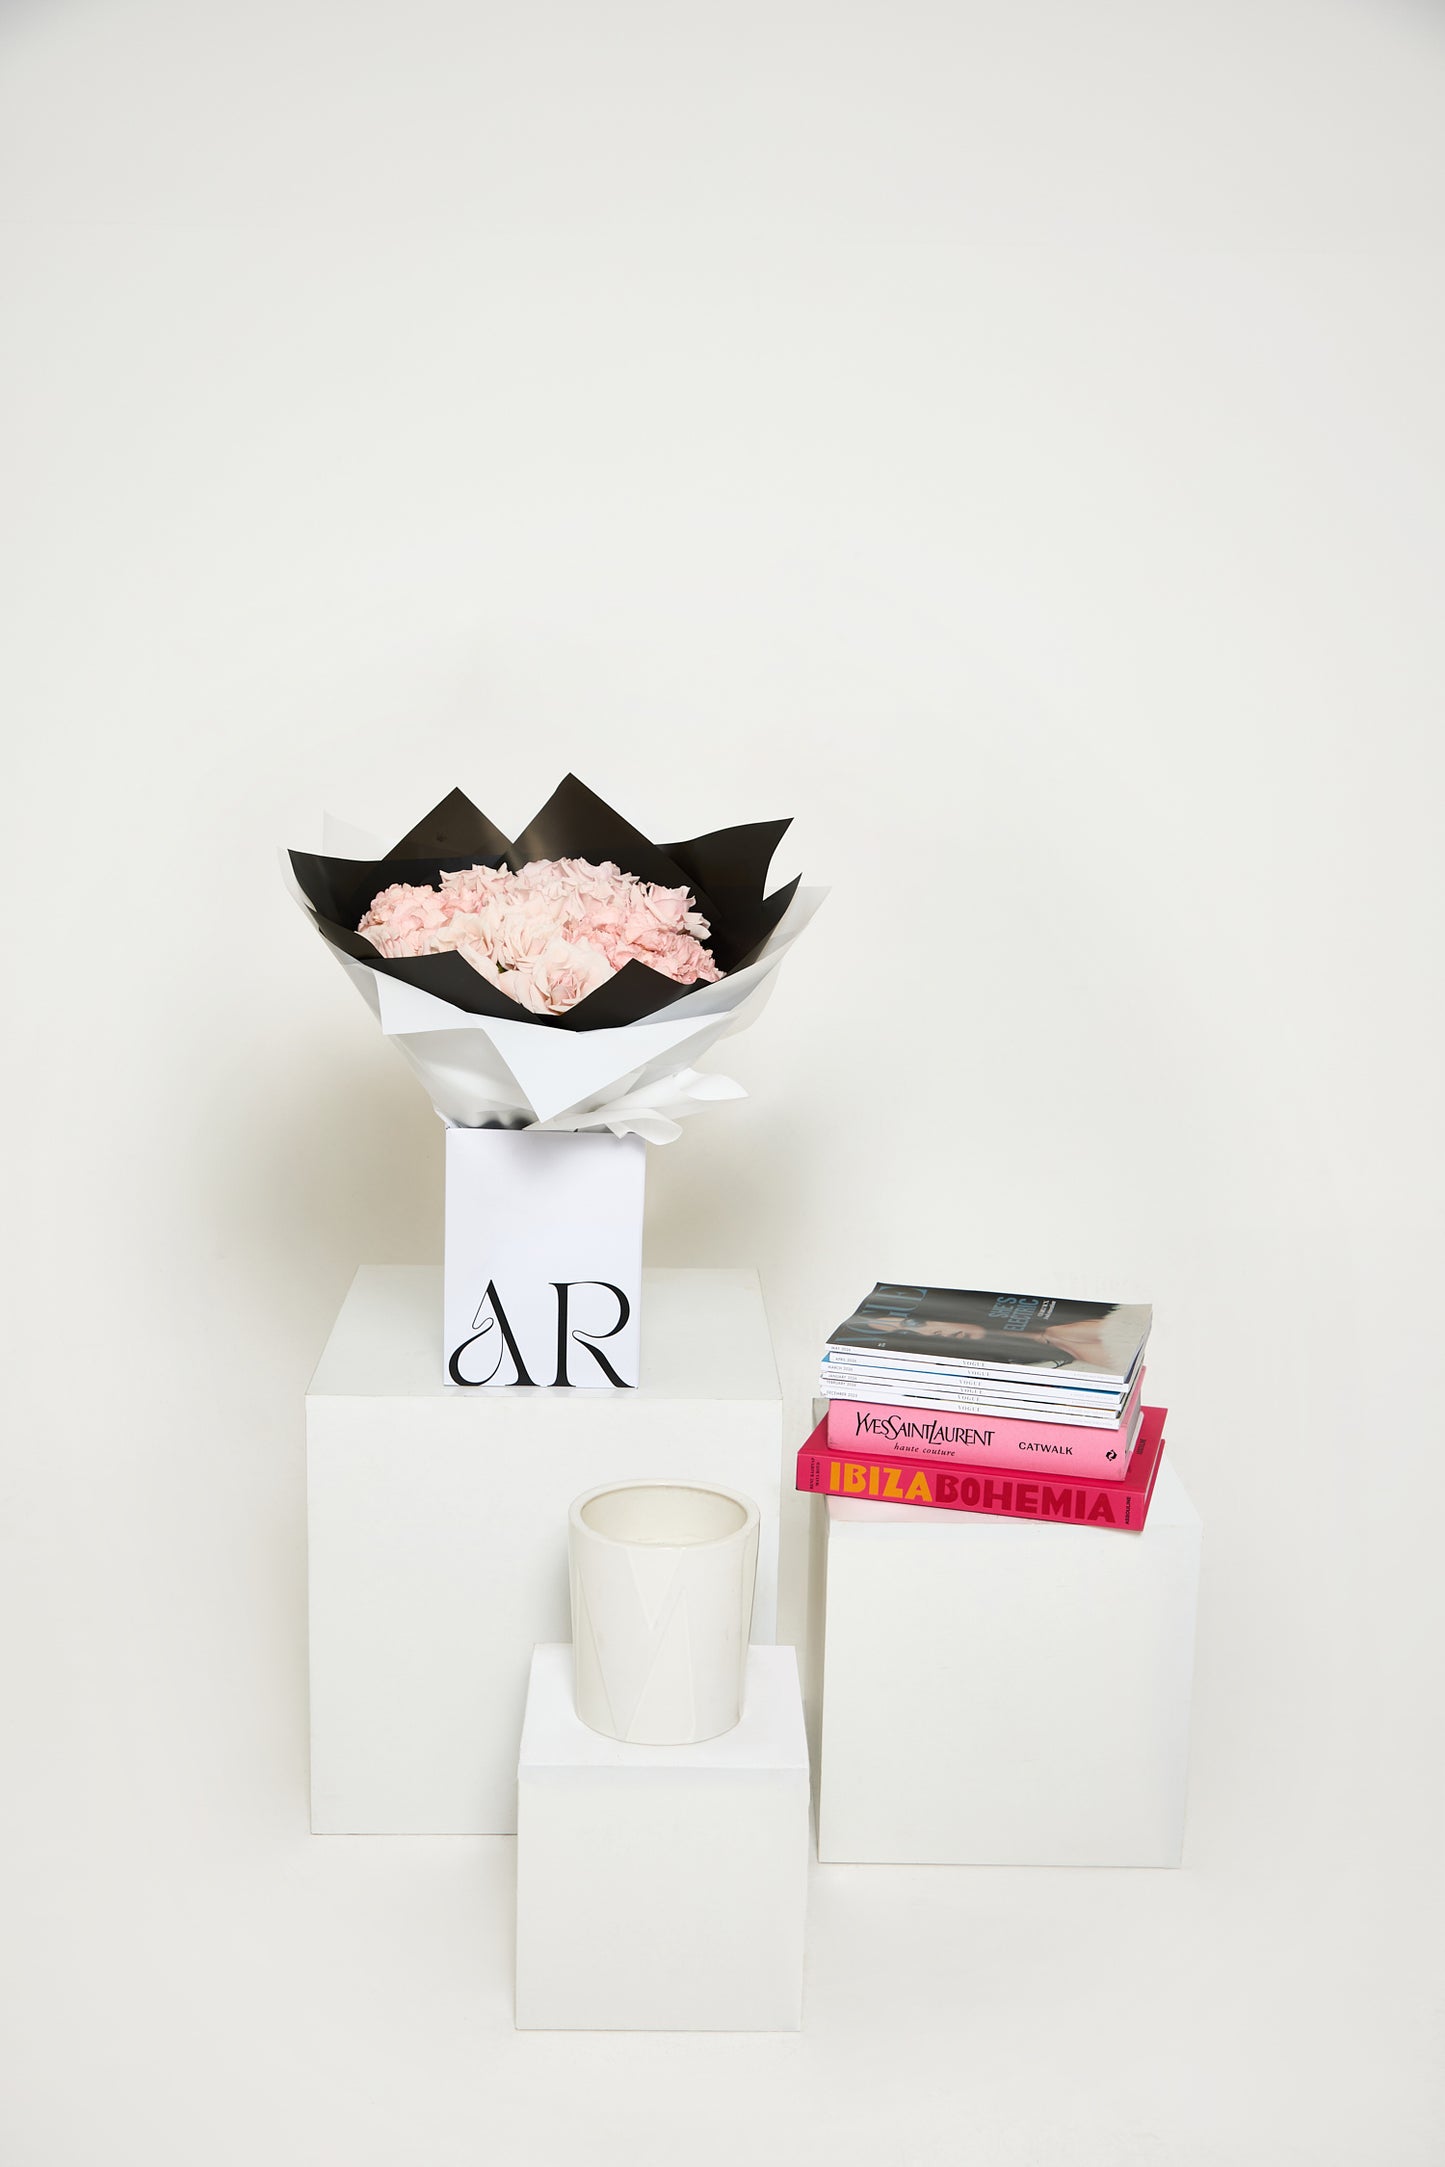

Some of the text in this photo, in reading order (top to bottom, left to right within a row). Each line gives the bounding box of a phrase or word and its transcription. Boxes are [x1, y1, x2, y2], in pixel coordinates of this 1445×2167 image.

[1003, 1298, 1040, 1331] ELECTRIC
[448, 1279, 635, 1388] AR
[893, 1442, 956, 1457] haute couture
[1018, 1441, 1073, 1455] CATWALK
[830, 1462, 1116, 1523] IBIZA BOHEMIA
